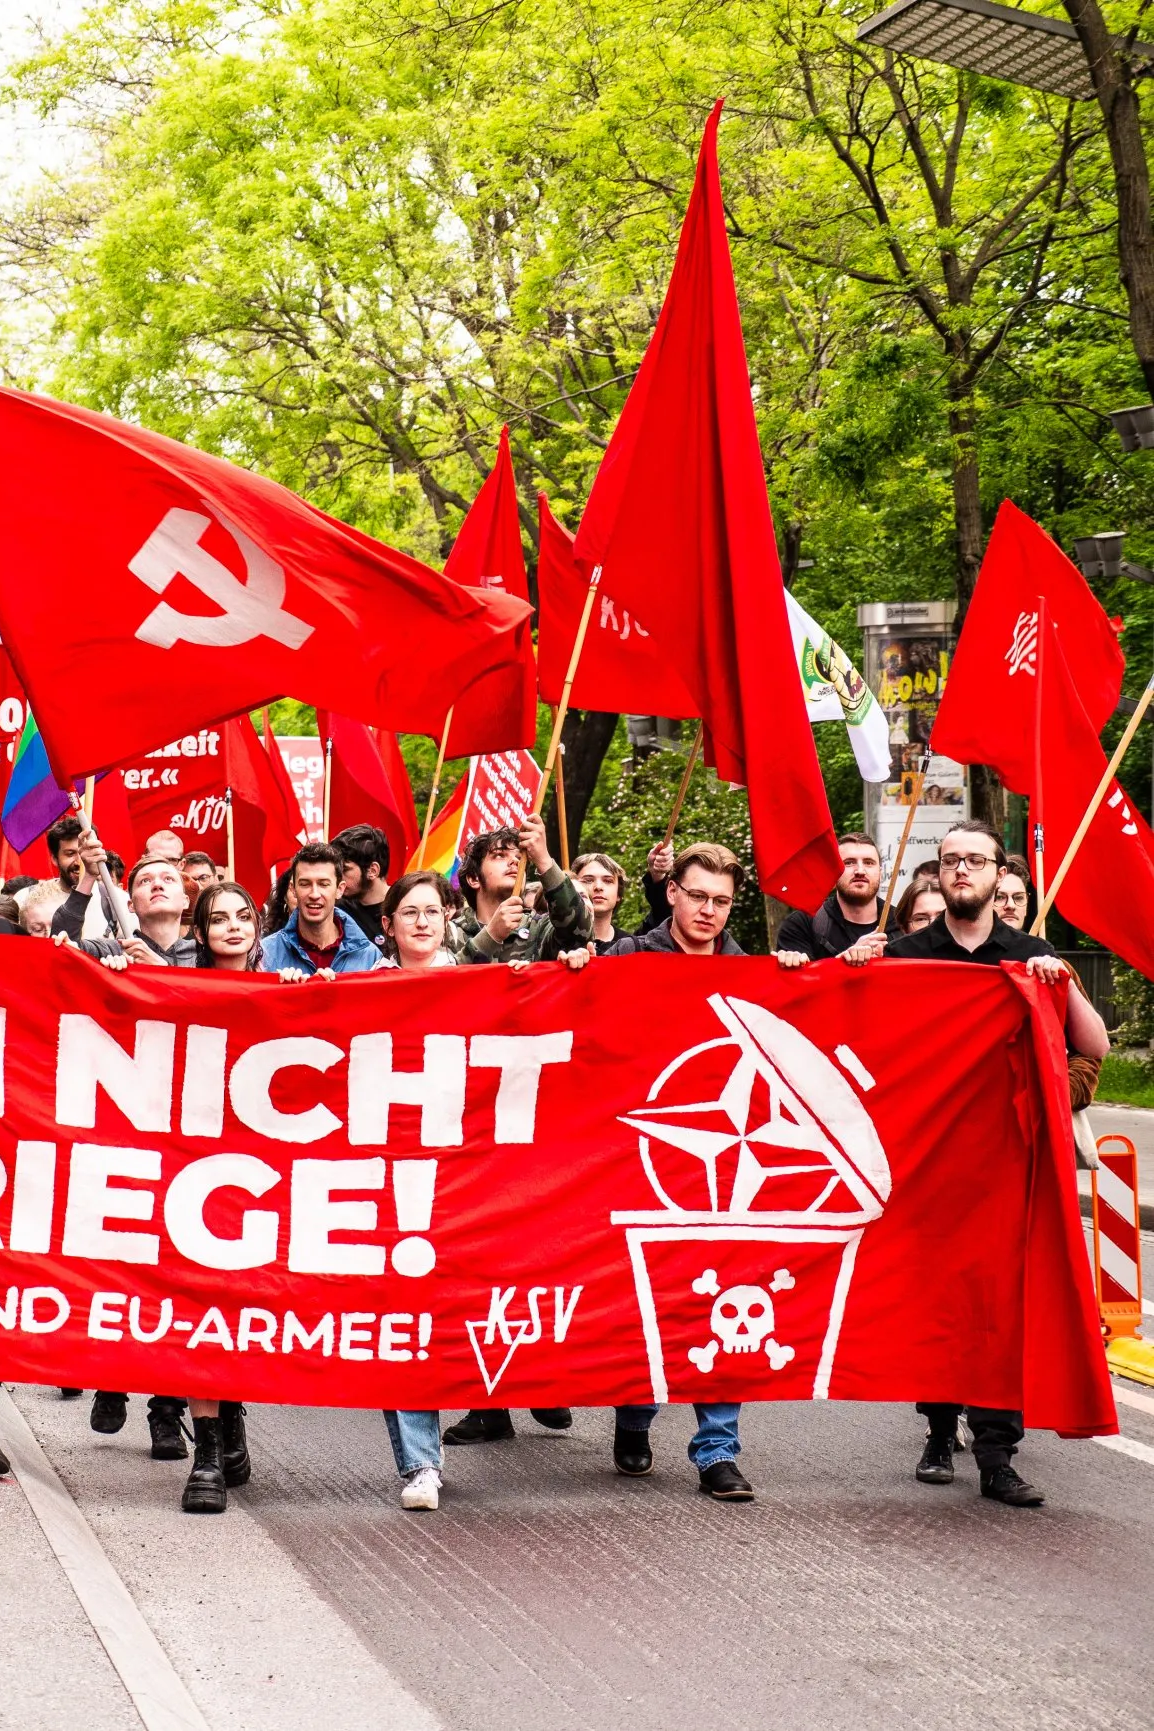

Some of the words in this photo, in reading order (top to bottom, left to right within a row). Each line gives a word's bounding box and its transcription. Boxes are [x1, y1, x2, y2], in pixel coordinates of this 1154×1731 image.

[122, 767, 179, 790] er.«
[55, 1014, 573, 1147] NICHT
[88, 1292, 432, 1361] EU-ARMEE!
[483, 1285, 584, 1345] KSV
